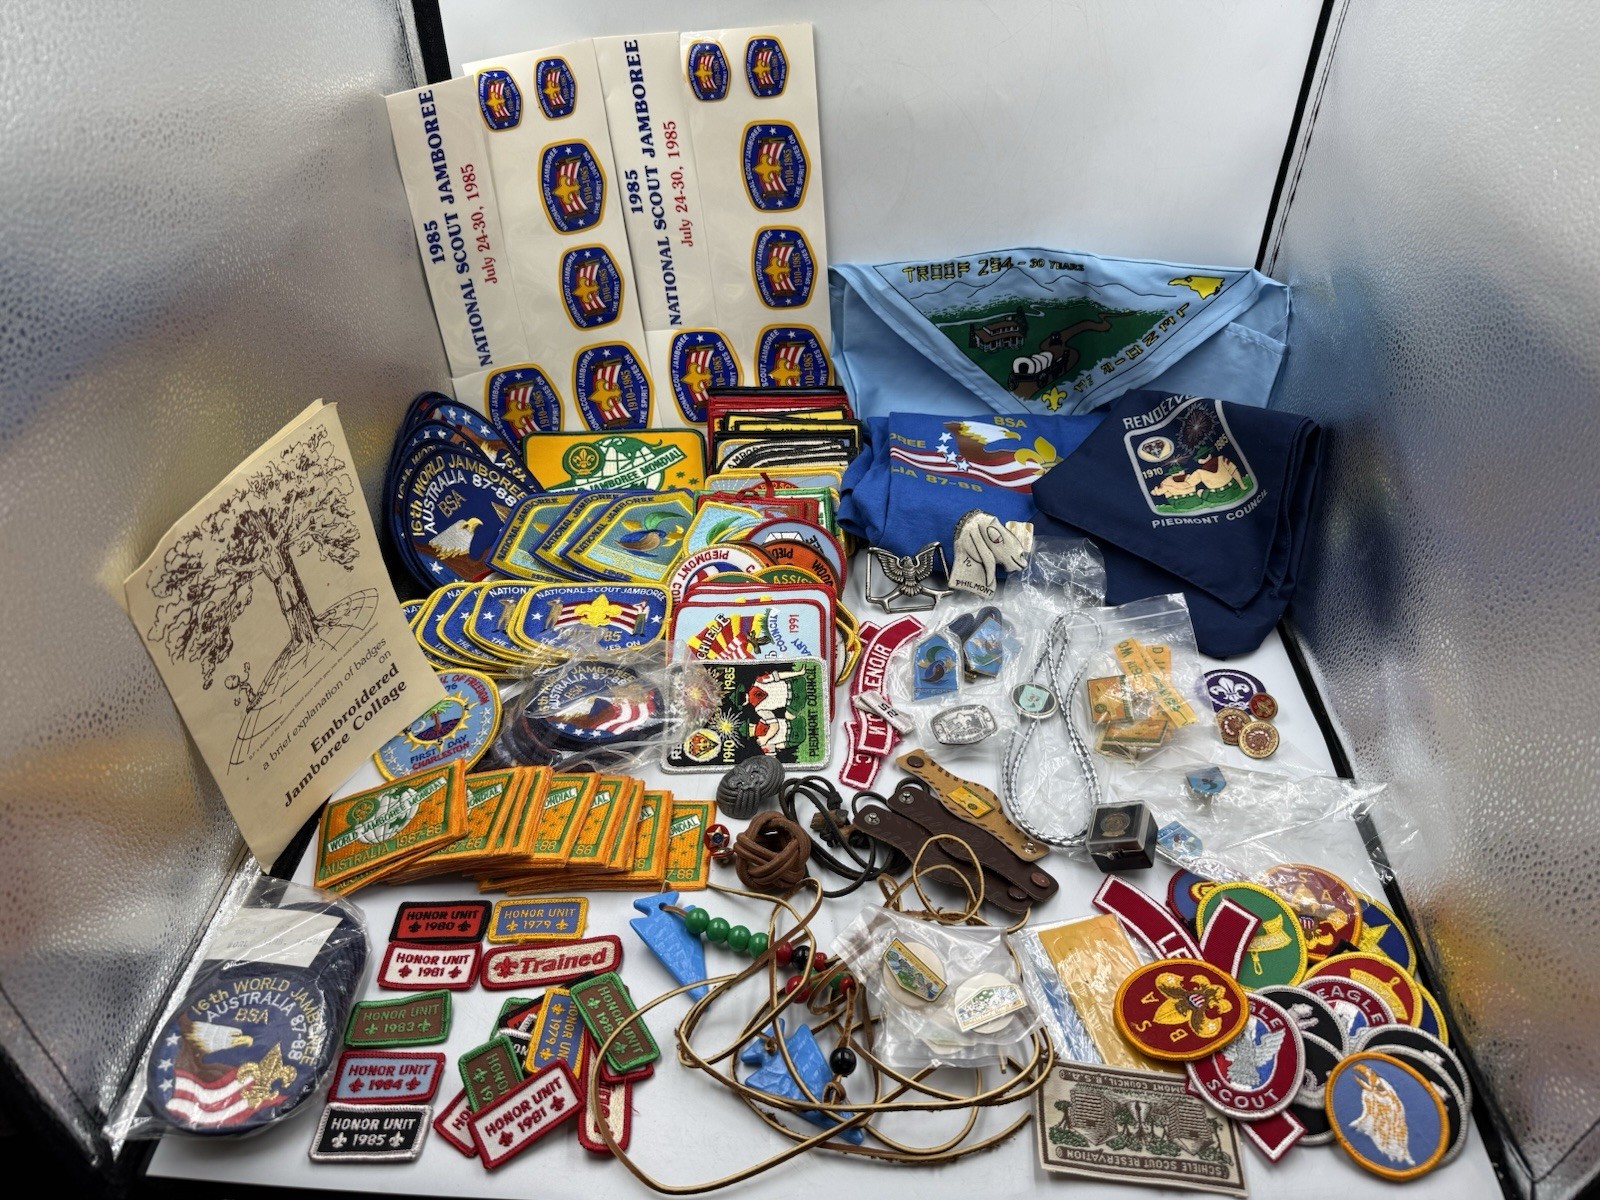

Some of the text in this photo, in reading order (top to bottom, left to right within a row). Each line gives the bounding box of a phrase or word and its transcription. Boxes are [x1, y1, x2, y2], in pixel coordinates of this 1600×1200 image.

[746, 126, 762, 159] JAMBOREE
[544, 148, 558, 182] JAMBOREE
[745, 159, 753, 180] SCOUT
[544, 183, 553, 205] SCOUT
[624, 39, 682, 325] NATIONAL SCOUT JAMBOREE
[625, 170, 643, 214] 1985
[663, 121, 693, 247] July 24-30, 1985
[419, 89, 493, 367] NATIONAL SCOUT JAMBOREE
[461, 164, 497, 283] July 24-30, 1985
[424, 220, 445, 264] 1985
[757, 230, 773, 260] JAMBOREE
[565, 252, 577, 283] JAMBOREE
[902, 260, 1085, 283] TROOP YEARS
[565, 285, 573, 304] SCOUT
[624, 354, 633, 364] ON
[716, 341, 734, 371] LIVES ON
[760, 330, 780, 387] SCOUT JAMBOREE
[809, 338, 825, 367] LIVES ON
[536, 376, 544, 385] ON
[579, 350, 594, 411] SCOUT JAMBOREE
[631, 365, 644, 383] LIVES
[672, 334, 698, 421] NATIONAL SCOUT JAMBOREE
[492, 373, 507, 408] JAMBOREE
[543, 386, 555, 403] LIVES
[621, 370, 638, 411] 1910-1985
[533, 391, 550, 428] 1910-1985
[993, 416, 1027, 428] BSA
[412, 456, 445, 497] WORLD
[642, 449, 683, 475] MONDIAL
[1143, 467, 1163, 479] 1910
[448, 454, 528, 500] JAMBOREE
[926, 474, 983, 492] 87-88
[422, 469, 467, 534] AUSTRALIA
[472, 473, 517, 506] 87-88
[438, 489, 467, 518] BSA
[1151, 489, 1268, 528] PIEDMONT COUNCIL
[410, 500, 425, 536] 16th
[497, 497, 559, 559] NATIONAL JAMBOREE
[575, 496, 654, 554] NATIONAL JAMBOREE
[542, 518, 573, 551] NATIONAL
[677, 550, 730, 581] PIEDMONT
[536, 588, 586, 599] NATIONAL
[620, 588, 666, 602] JAMBOREE
[955, 579, 994, 596] PHILMONT
[788, 614, 799, 633] 1991
[456, 640, 471, 649] THE
[492, 638, 508, 646] THE
[378, 650, 392, 664] on
[724, 667, 735, 689] 1985
[263, 638, 387, 771] a brief explanation of badges
[310, 663, 399, 754] Embroidered
[807, 666, 820, 757] PIEDMONT COUNCIL
[284, 732, 351, 807] Jamboree
[352, 680, 407, 731] Collage
[410, 734, 467, 763] FIRST DAY
[412, 741, 470, 770] CHARLESTON
[723, 739, 735, 763] 1910
[329, 779, 445, 852] WORLD JAMBOREE MONDIAL
[325, 842, 389, 877] AUSTRALIA
[396, 825, 443, 849] 1987-88
[406, 909, 479, 919] HONOR UNIT
[425, 921, 454, 930] 1980
[504, 909, 576, 918] HONOR UNIT
[523, 920, 551, 930] 1979
[396, 953, 470, 964] HONOR UNIT
[418, 967, 444, 976] 1981
[520, 948, 607, 974] Trained
[192, 989, 229, 1015] 16th
[233, 978, 290, 994] WORLD
[1316, 985, 1385, 1023] EAGLE
[207, 992, 307, 1060] AUSTRALIA 87-88
[235, 1008, 269, 1024] BSA
[363, 1005, 439, 1021] HONOR UNIT
[384, 1022, 414, 1033] 1983
[544, 1019, 560, 1046] 1979
[623, 1027, 644, 1054] UNIT
[349, 1065, 431, 1076] HONOR UNIT
[369, 1080, 402, 1090] 1984
[484, 1099, 531, 1137] HONOR
[532, 1076, 562, 1103] UNIT
[1207, 1078, 1279, 1108] SCOUT
[331, 1118, 416, 1130] HONOR UNIT
[517, 1107, 547, 1133] 1981
[353, 1134, 386, 1146] 1985
[1067, 1149, 1221, 1174] SCHIELE SCOUT RESERVATION
